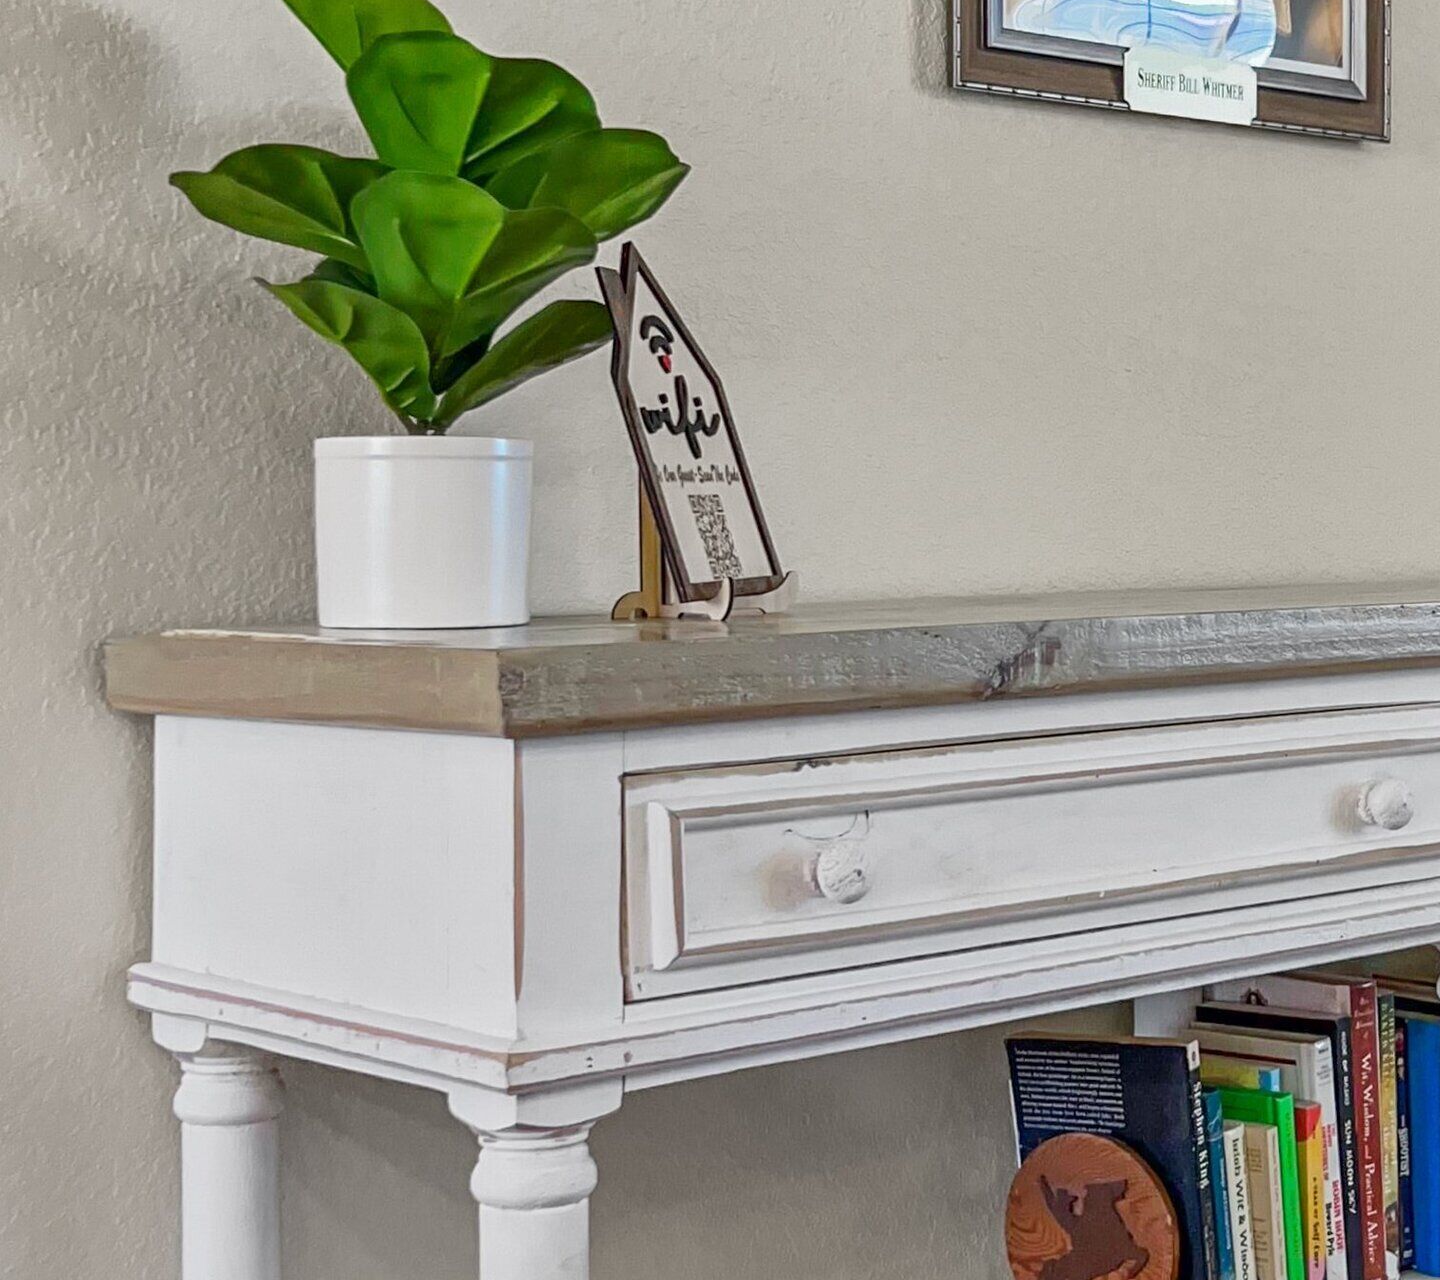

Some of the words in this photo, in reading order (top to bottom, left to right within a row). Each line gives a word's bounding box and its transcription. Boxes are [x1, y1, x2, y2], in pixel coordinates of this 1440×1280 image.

[1138, 67, 1175, 91] SHERIFF
[1178, 73, 1200, 94] BILL
[1202, 77, 1244, 101] WHITMER
[640, 375, 720, 460] wifi
[1191, 1081, 1205, 1145] Stephen
[1198, 1150, 1210, 1190] King
[1344, 1119, 1352, 1145] SUN
[1346, 1149, 1354, 1185] MOON
[1235, 1179, 1246, 1211] Wit
[1364, 1162, 1377, 1217] Practical
[1366, 1220, 1379, 1265] Advice
